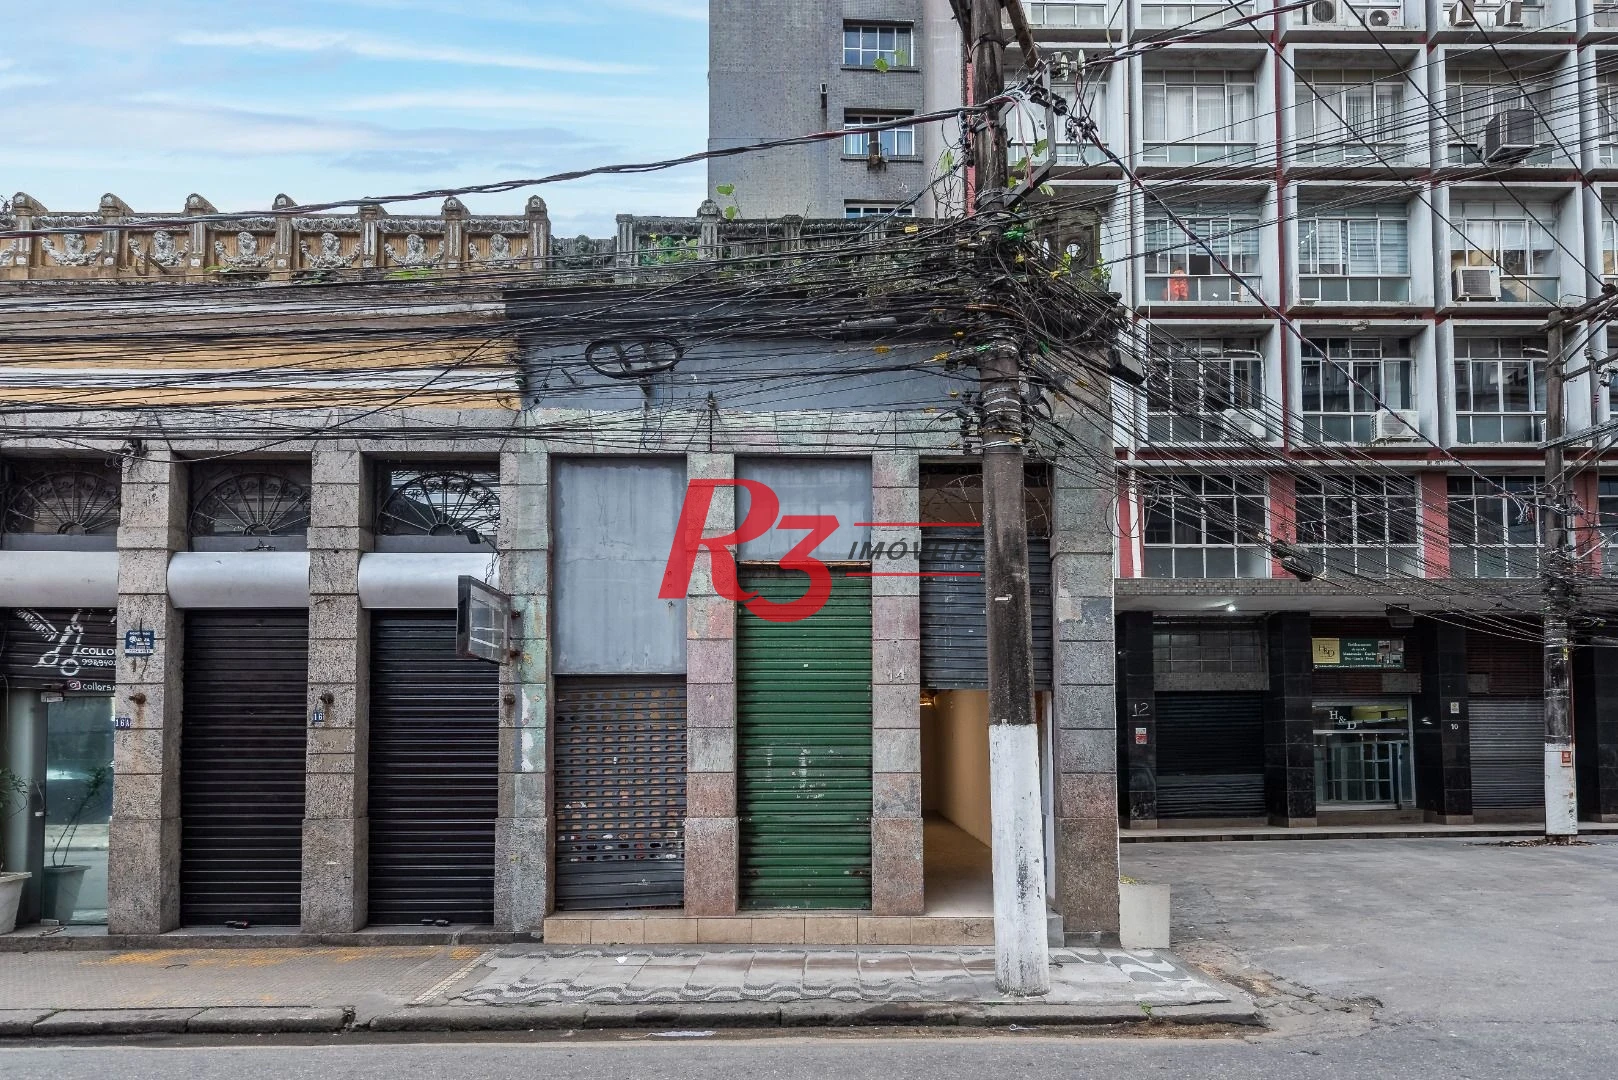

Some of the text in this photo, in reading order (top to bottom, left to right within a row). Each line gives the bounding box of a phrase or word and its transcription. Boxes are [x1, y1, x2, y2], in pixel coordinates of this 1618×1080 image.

[80, 647, 116, 656] COLLO
[887, 665, 906, 682] 14
[1131, 702, 1151, 717] 12
[115, 719, 130, 728] 16A
